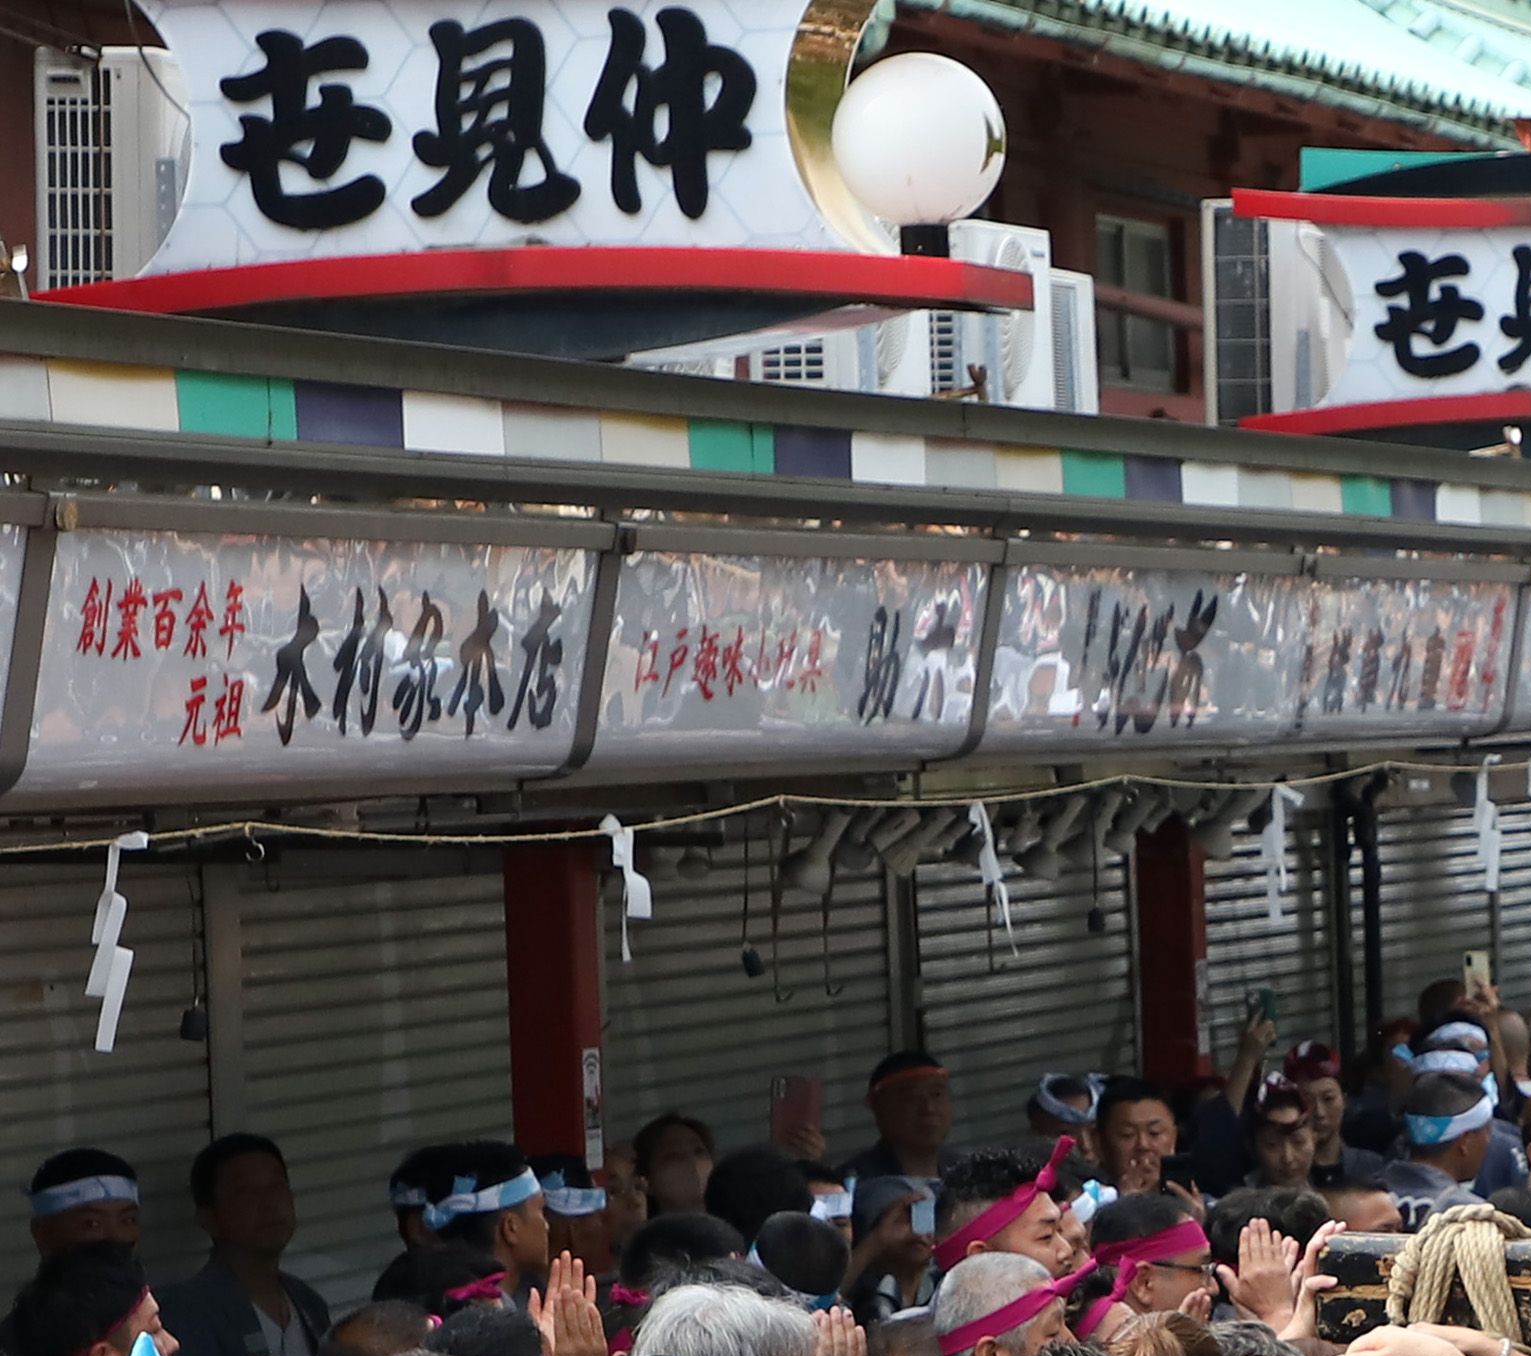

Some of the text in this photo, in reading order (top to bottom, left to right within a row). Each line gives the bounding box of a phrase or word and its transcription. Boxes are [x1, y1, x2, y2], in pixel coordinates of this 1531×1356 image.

[76, 577, 246, 662] 創業百余年
[261, 582, 563, 746] 木村家本店
[178, 673, 243, 747] 元祖
